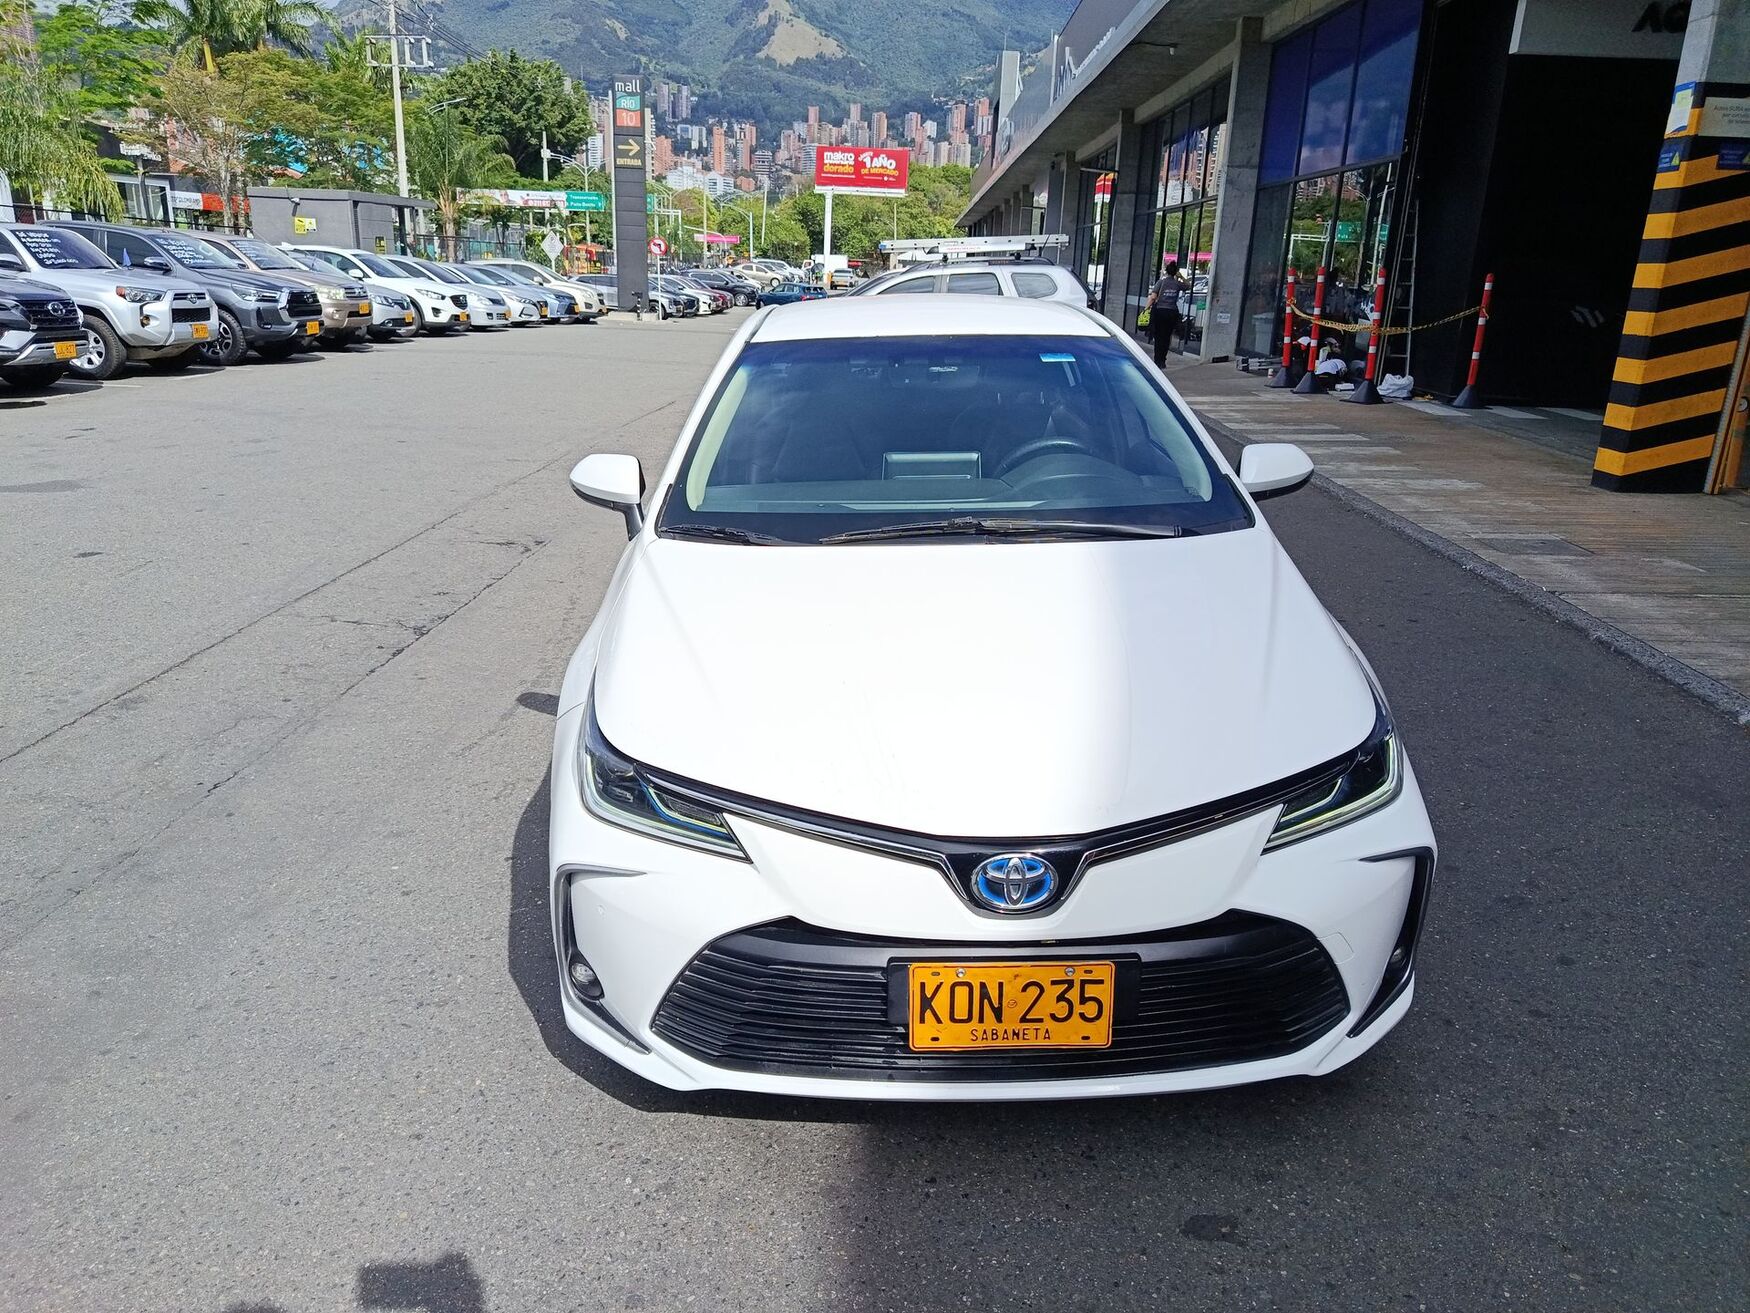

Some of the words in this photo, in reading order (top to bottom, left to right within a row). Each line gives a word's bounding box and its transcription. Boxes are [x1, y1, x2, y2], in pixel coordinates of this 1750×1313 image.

[615, 79, 641, 93] mall
[622, 112, 636, 126] 10
[616, 158, 642, 166] ENTRADA
[823, 151, 855, 161] makro
[872, 153, 897, 170] AÑO
[823, 163, 855, 174] dorado
[870, 168, 900, 177] MERCADO
[918, 980, 1004, 1025] KON
[1019, 978, 1105, 1024] 235
[970, 1028, 1051, 1041] SABANETA
